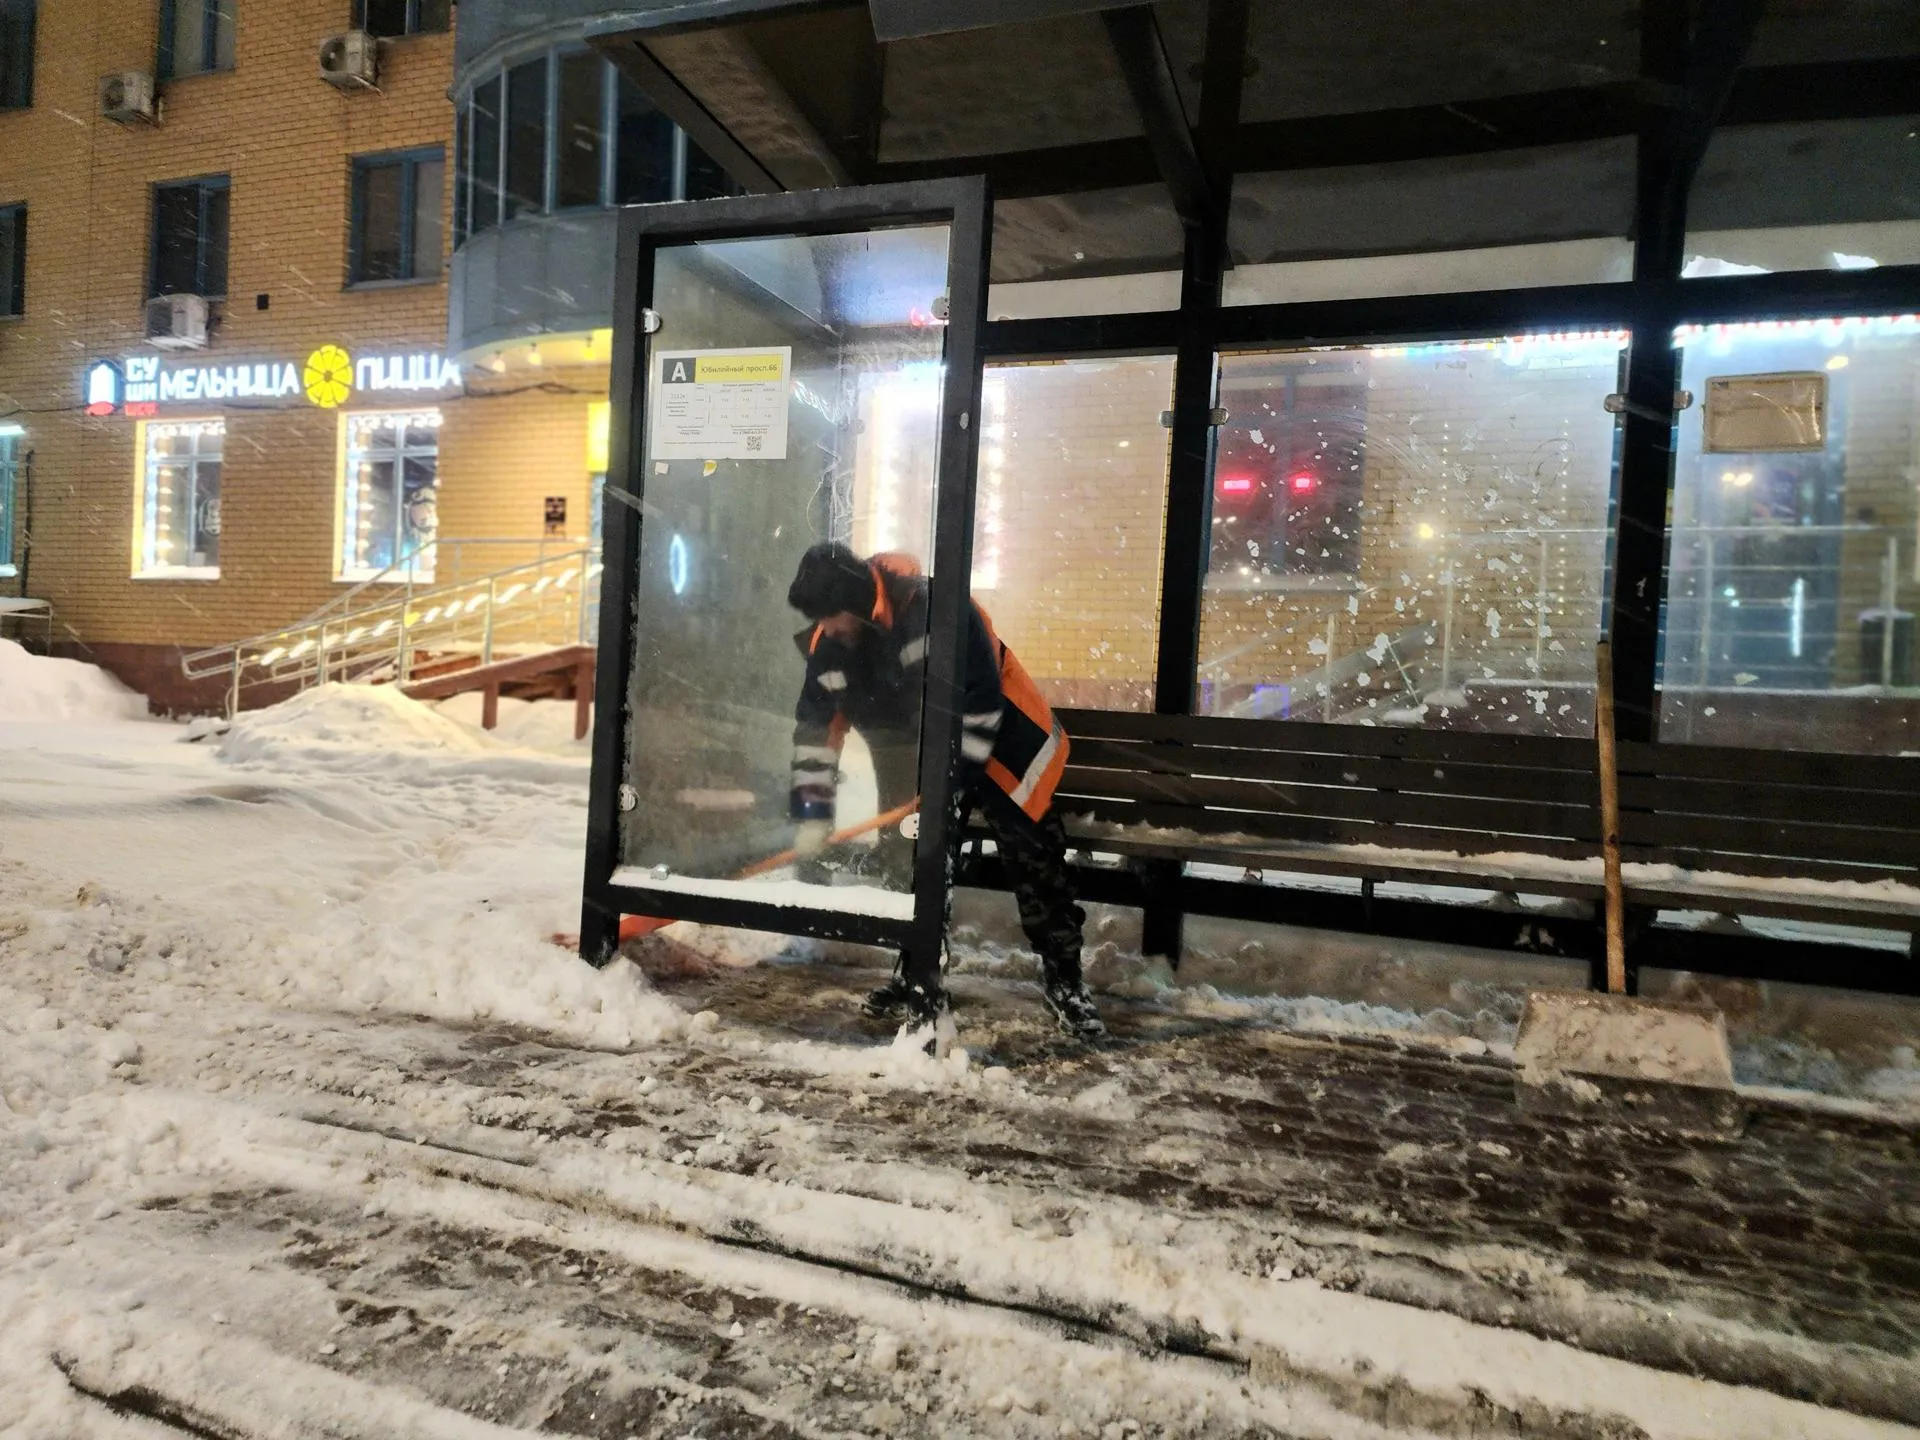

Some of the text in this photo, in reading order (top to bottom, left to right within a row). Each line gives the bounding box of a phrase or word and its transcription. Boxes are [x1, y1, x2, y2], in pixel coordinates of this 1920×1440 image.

[126, 356, 159, 381] СУ
[160, 354, 462, 401] МЕЛЬНИЦА ПИЦЦА
[701, 365, 744, 373] Юбилейный
[125, 383, 158, 401] ШИ
